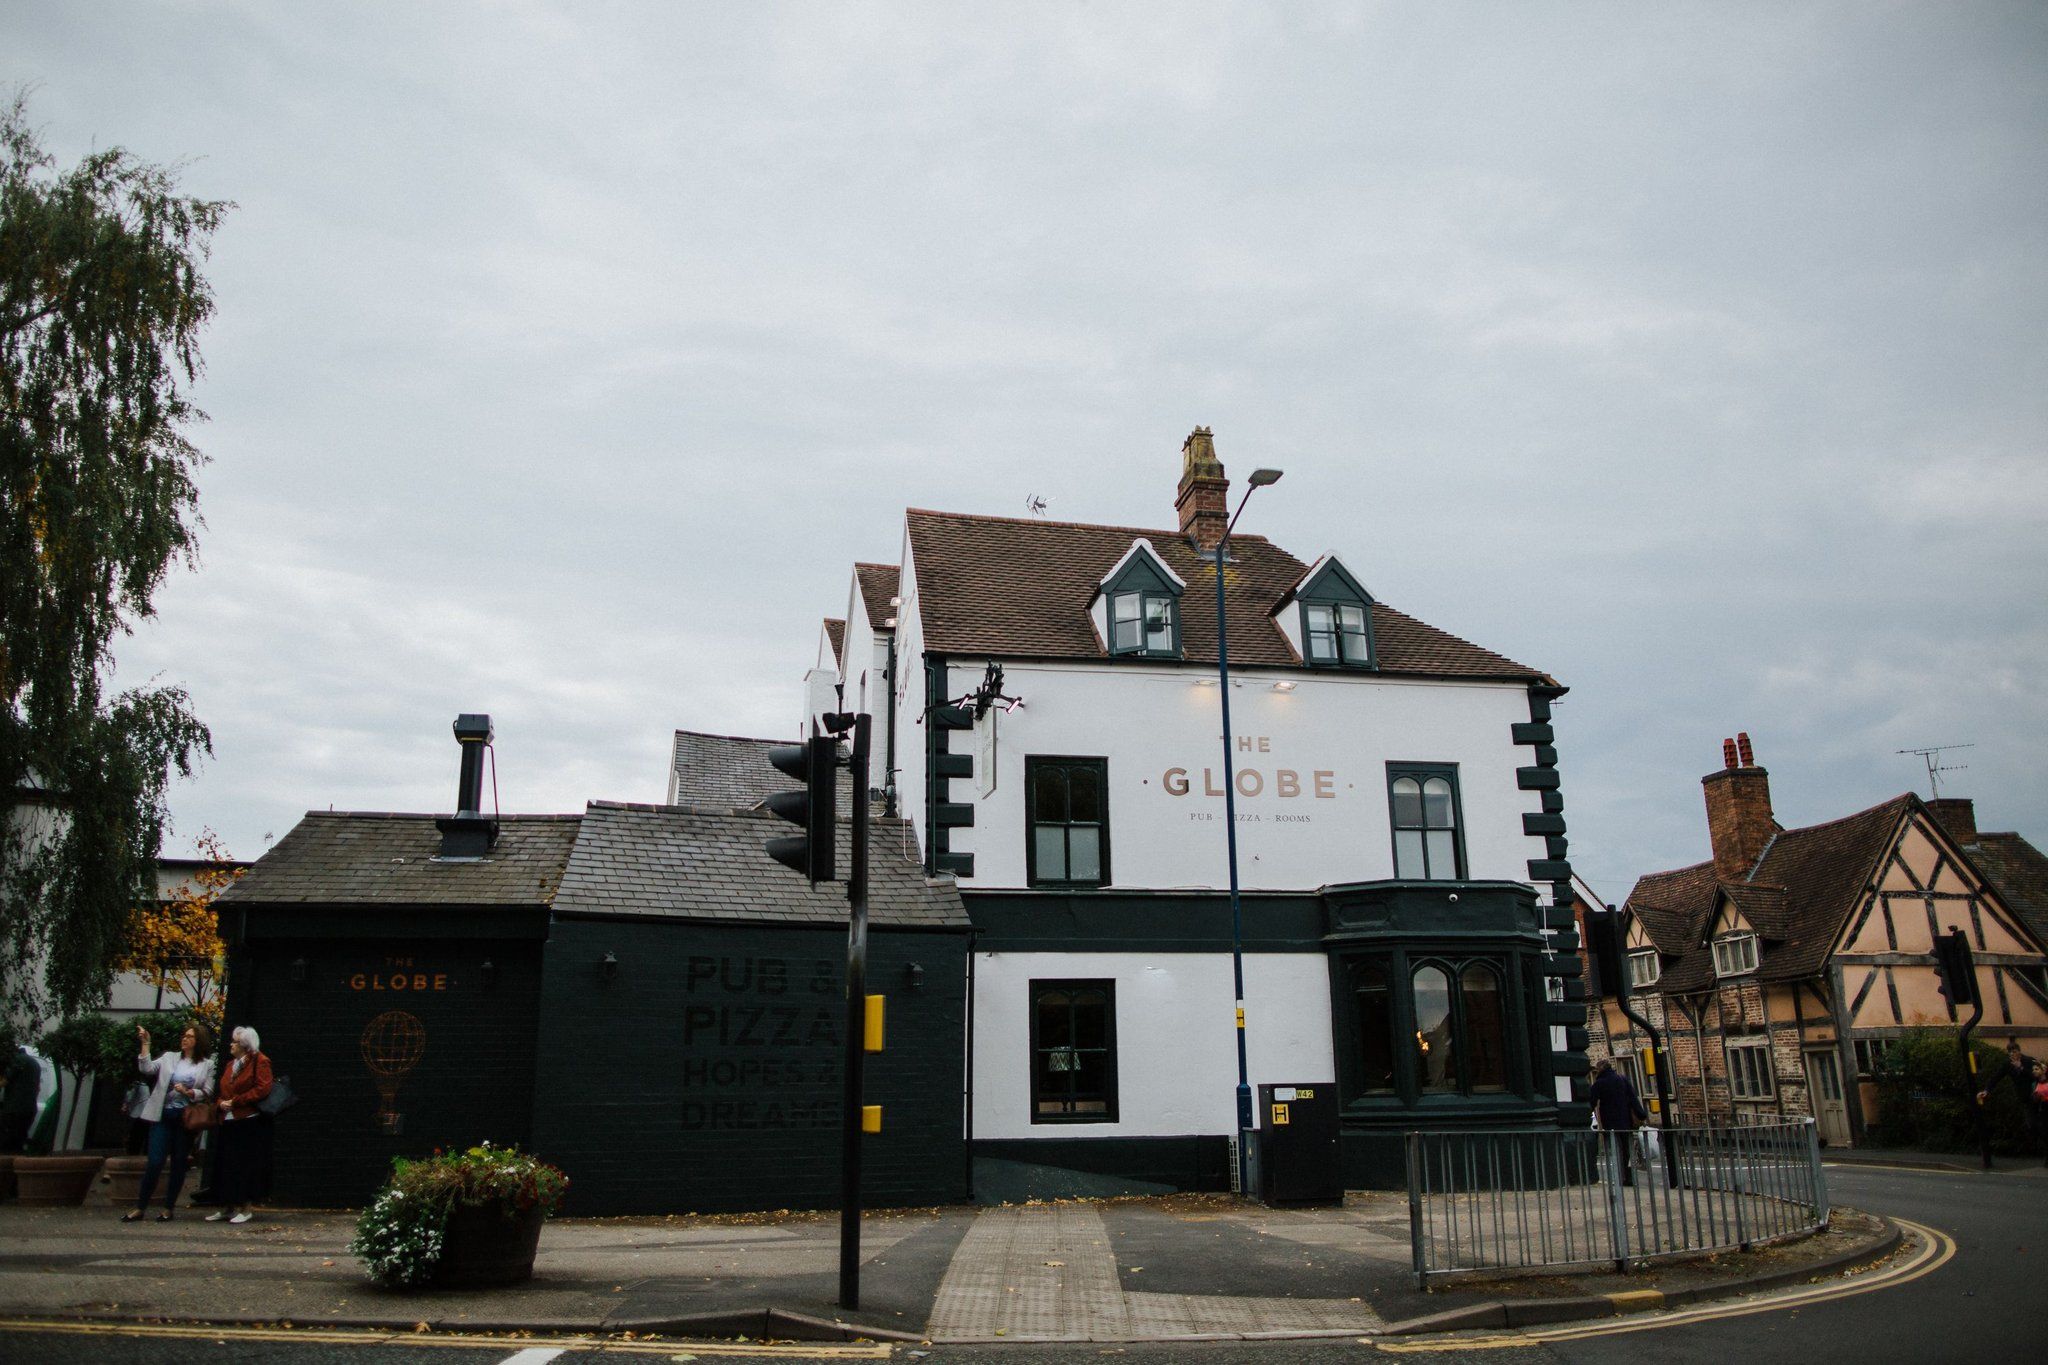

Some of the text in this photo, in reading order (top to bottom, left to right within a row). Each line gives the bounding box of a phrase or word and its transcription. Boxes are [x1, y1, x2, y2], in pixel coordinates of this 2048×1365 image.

[1219, 736, 1271, 752] HE
[1162, 767, 1336, 798] GLOBE
[1190, 813, 1311, 823] PUB IZZA ROOMS
[384, 956, 415, 968] THE
[350, 973, 448, 991] GLOBE
[687, 956, 788, 993] PUB
[684, 1006, 841, 1046] PIZZA
[683, 1058, 804, 1087] HOPES
[1297, 1090, 1313, 1098] W42
[680, 1101, 839, 1130] DREAMS
[1274, 1106, 1287, 1122] H
